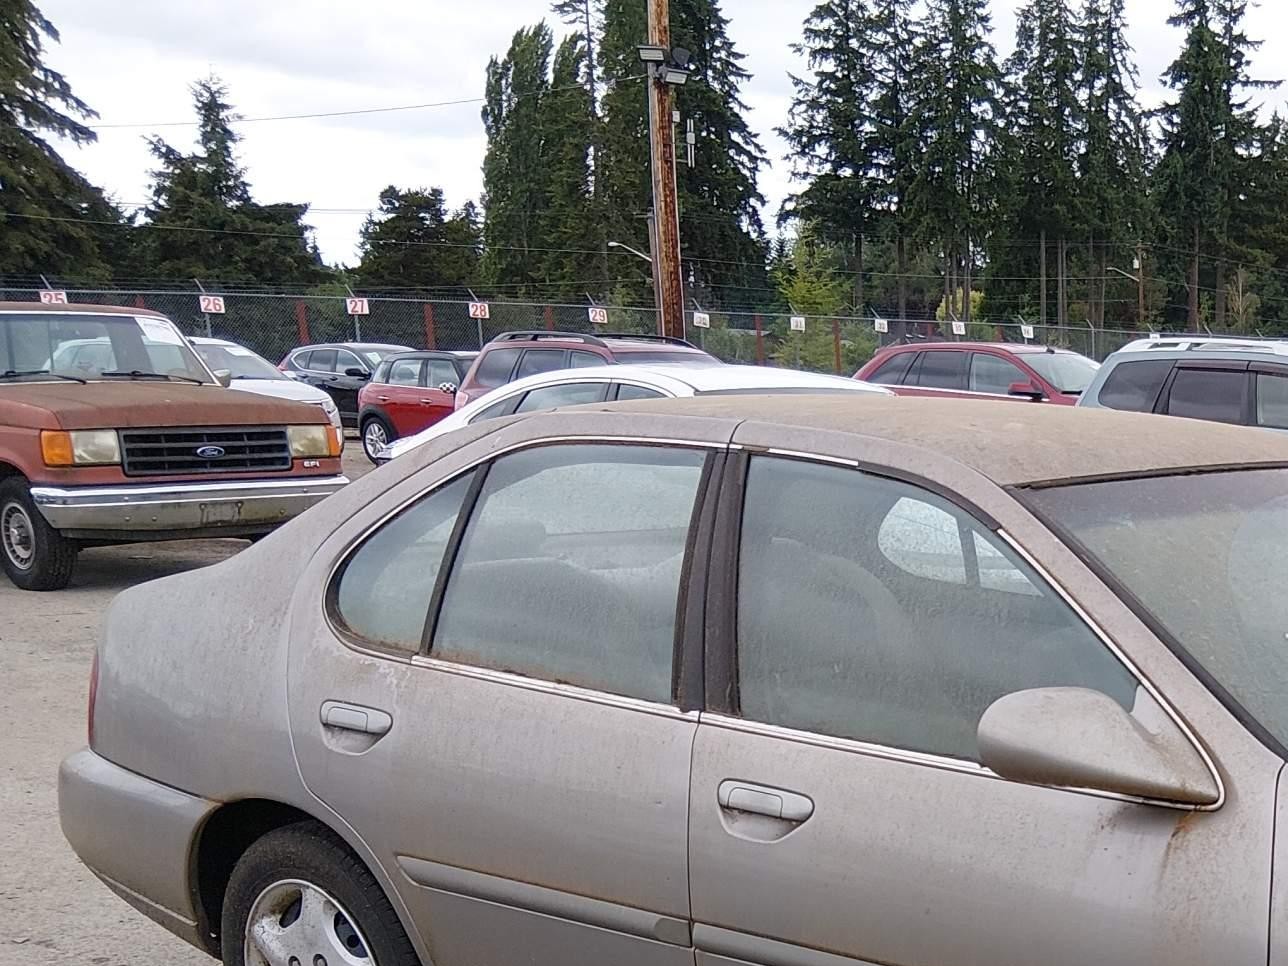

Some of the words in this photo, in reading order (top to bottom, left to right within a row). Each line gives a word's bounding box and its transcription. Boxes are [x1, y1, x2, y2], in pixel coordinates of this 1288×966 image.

[42, 292, 65, 303] 25
[201, 297, 223, 312] 26
[349, 299, 365, 313] 27
[471, 303, 487, 317] 28
[590, 308, 606, 321] 29
[303, 460, 320, 468] EFI
